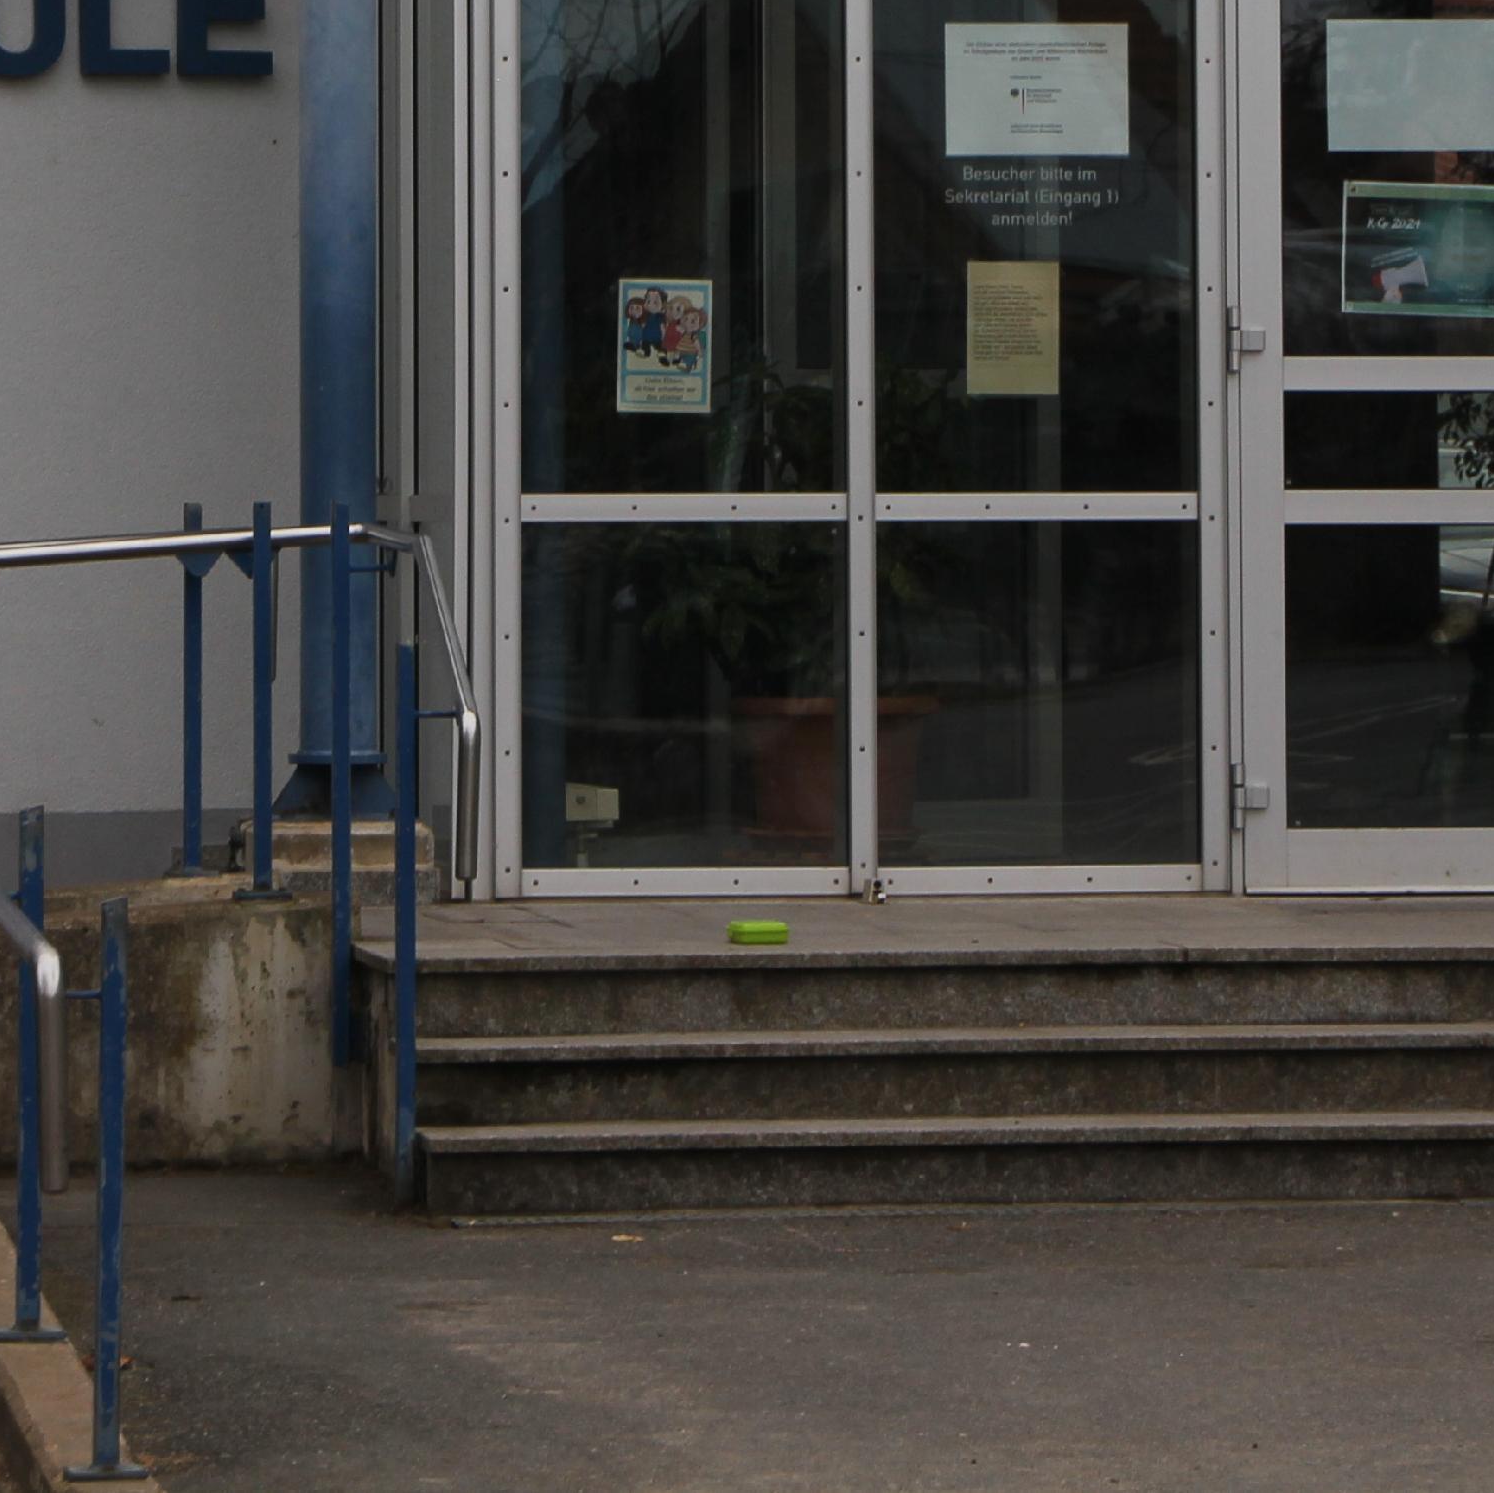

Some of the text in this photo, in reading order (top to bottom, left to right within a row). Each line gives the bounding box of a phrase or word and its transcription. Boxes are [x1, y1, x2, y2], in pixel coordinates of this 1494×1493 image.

[963, 165, 1097, 181] Besucher bitte im
[944, 189, 1030, 204] Sekretariat
[1035, 189, 1101, 207] (Eingang
[991, 211, 1073, 226] anmelden!
